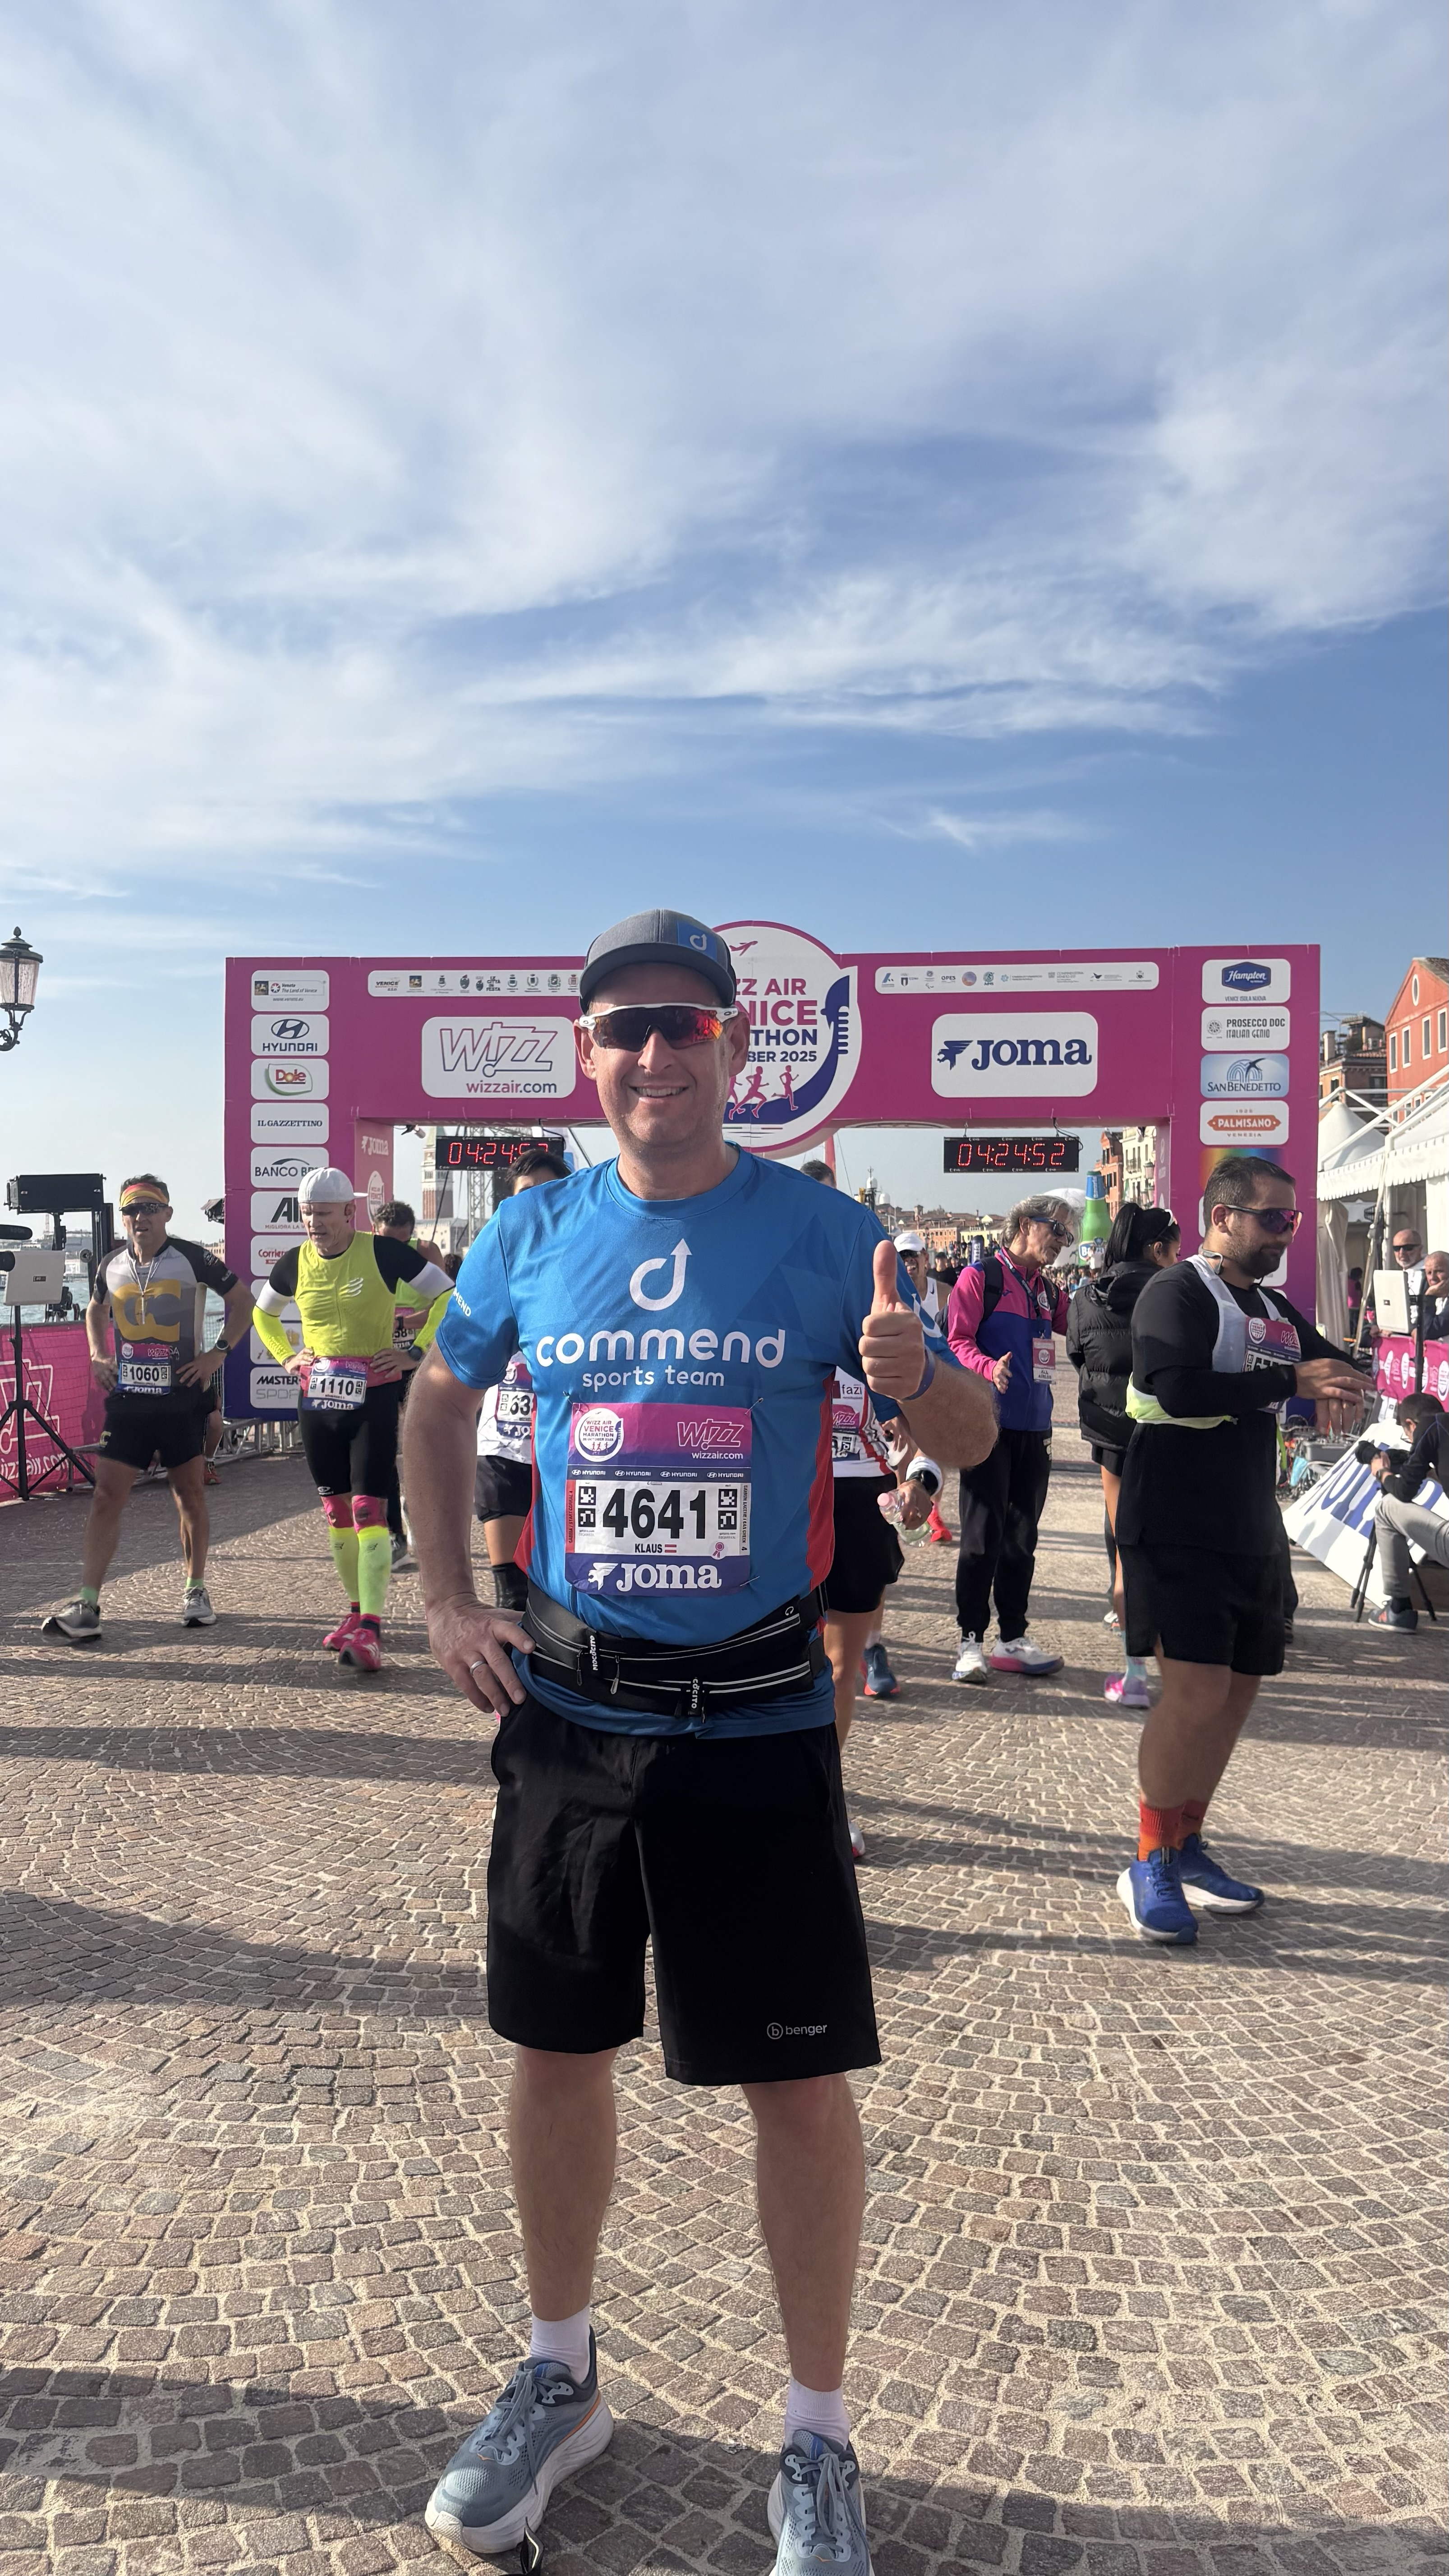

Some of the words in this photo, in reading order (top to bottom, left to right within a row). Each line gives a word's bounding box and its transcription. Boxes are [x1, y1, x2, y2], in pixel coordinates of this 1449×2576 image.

[1225, 970, 1267, 982] Hampton
[764, 978, 806, 996] AIR
[1227, 1018, 1267, 1028] PROSECCO
[1269, 1018, 1285, 1027] DOC
[1226, 1029, 1250, 1039] ITALIAN
[1251, 1029, 1270, 1038] GENIO
[262, 1043, 318, 1052] HYUNDAI
[780, 1050, 817, 1063] 2025
[276, 1069, 307, 1082] Dole
[466, 1081, 557, 1095] wizzair.com
[1218, 1118, 1271, 1128] PALMISANO
[958, 1143, 1064, 1166] 04:24:52
[255, 1166, 298, 1177] BANCO
[258, 1248, 285, 1258] Corrier
[536, 1328, 786, 1368] commend
[129, 1366, 160, 1381] 1060
[582, 1366, 655, 1393] sports
[664, 1364, 725, 1387] team
[320, 1378, 354, 1396] 1110
[691, 1451, 744, 1460] wizzair.com
[603, 1488, 706, 1540] 4641
[635, 1543, 663, 1553] KLAUS
[786, 2024, 828, 2036] benger
